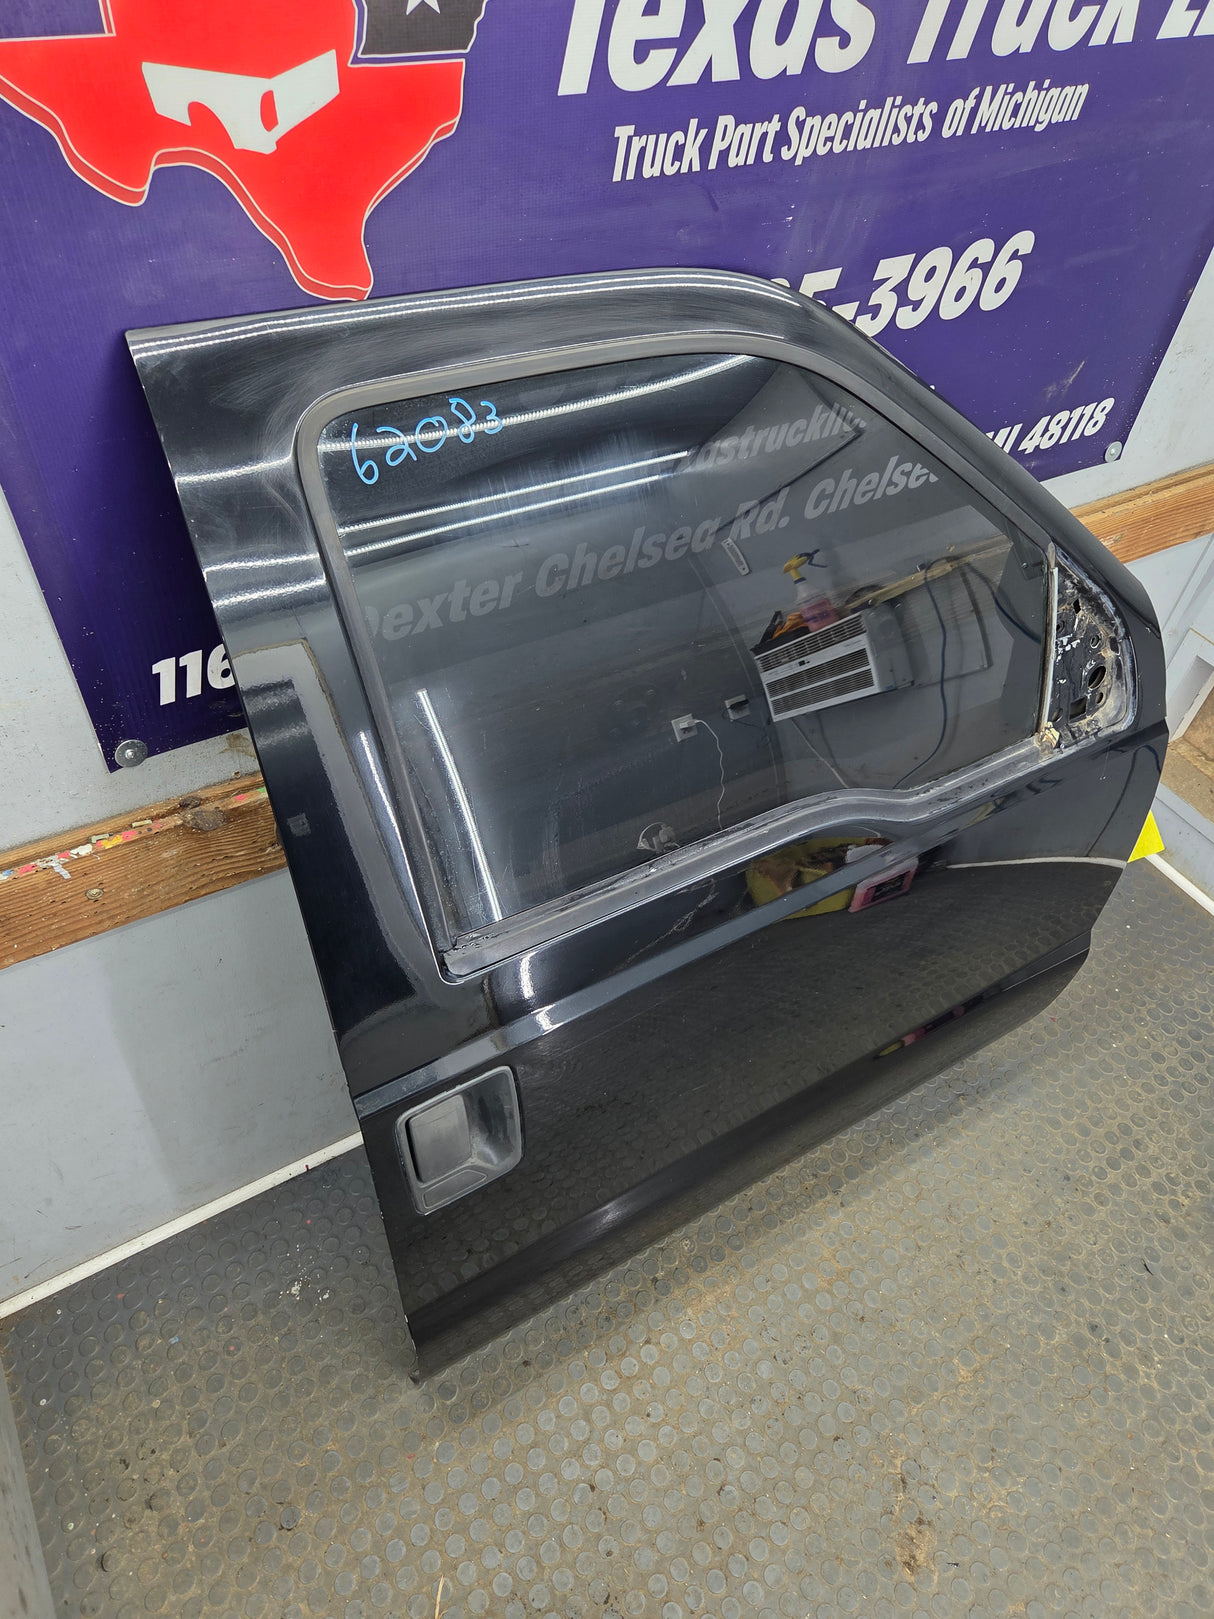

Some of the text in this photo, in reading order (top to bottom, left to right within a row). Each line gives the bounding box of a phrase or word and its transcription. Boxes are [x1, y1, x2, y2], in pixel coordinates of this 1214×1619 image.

[612, 78, 1090, 182] Truck Part Specialists of Michigan
[770, 230, 1035, 338] -3966
[351, 397, 503, 485] 62083
[535, 516, 722, 598] Chelsea
[728, 485, 790, 541] Rd.
[803, 455, 939, 520] Chelse
[1018, 397, 1115, 455] 48118
